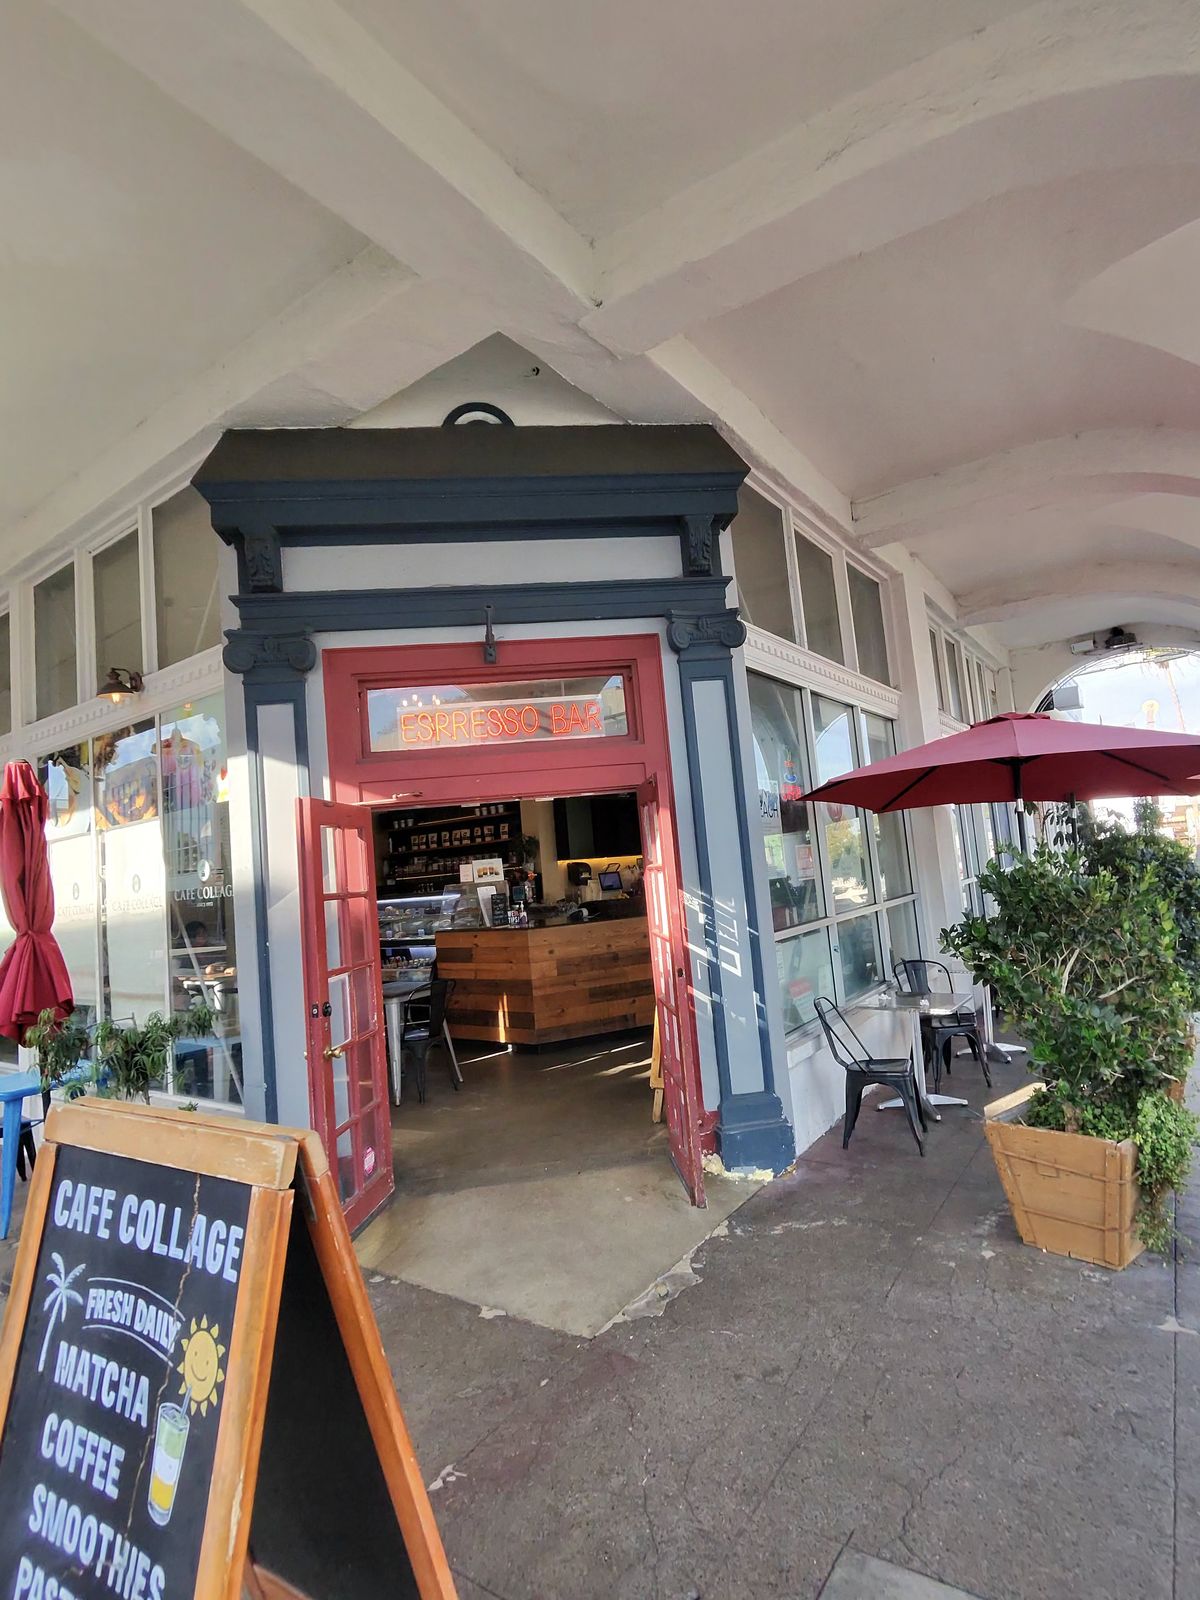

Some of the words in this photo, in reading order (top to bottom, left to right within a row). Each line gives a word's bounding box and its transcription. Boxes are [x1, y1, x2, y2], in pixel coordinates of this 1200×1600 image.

[551, 702, 602, 734] BAR
[197, 884, 234, 899] COLLAG
[54, 1180, 116, 1240] CAFE
[119, 1194, 244, 1283] COLLAGE
[85, 1288, 135, 1326] FRESH
[134, 1298, 182, 1353] DAILY
[54, 1340, 150, 1429] MATCHA
[40, 1412, 126, 1500] COFFEE
[28, 1483, 166, 1600] SMOOTHIES
